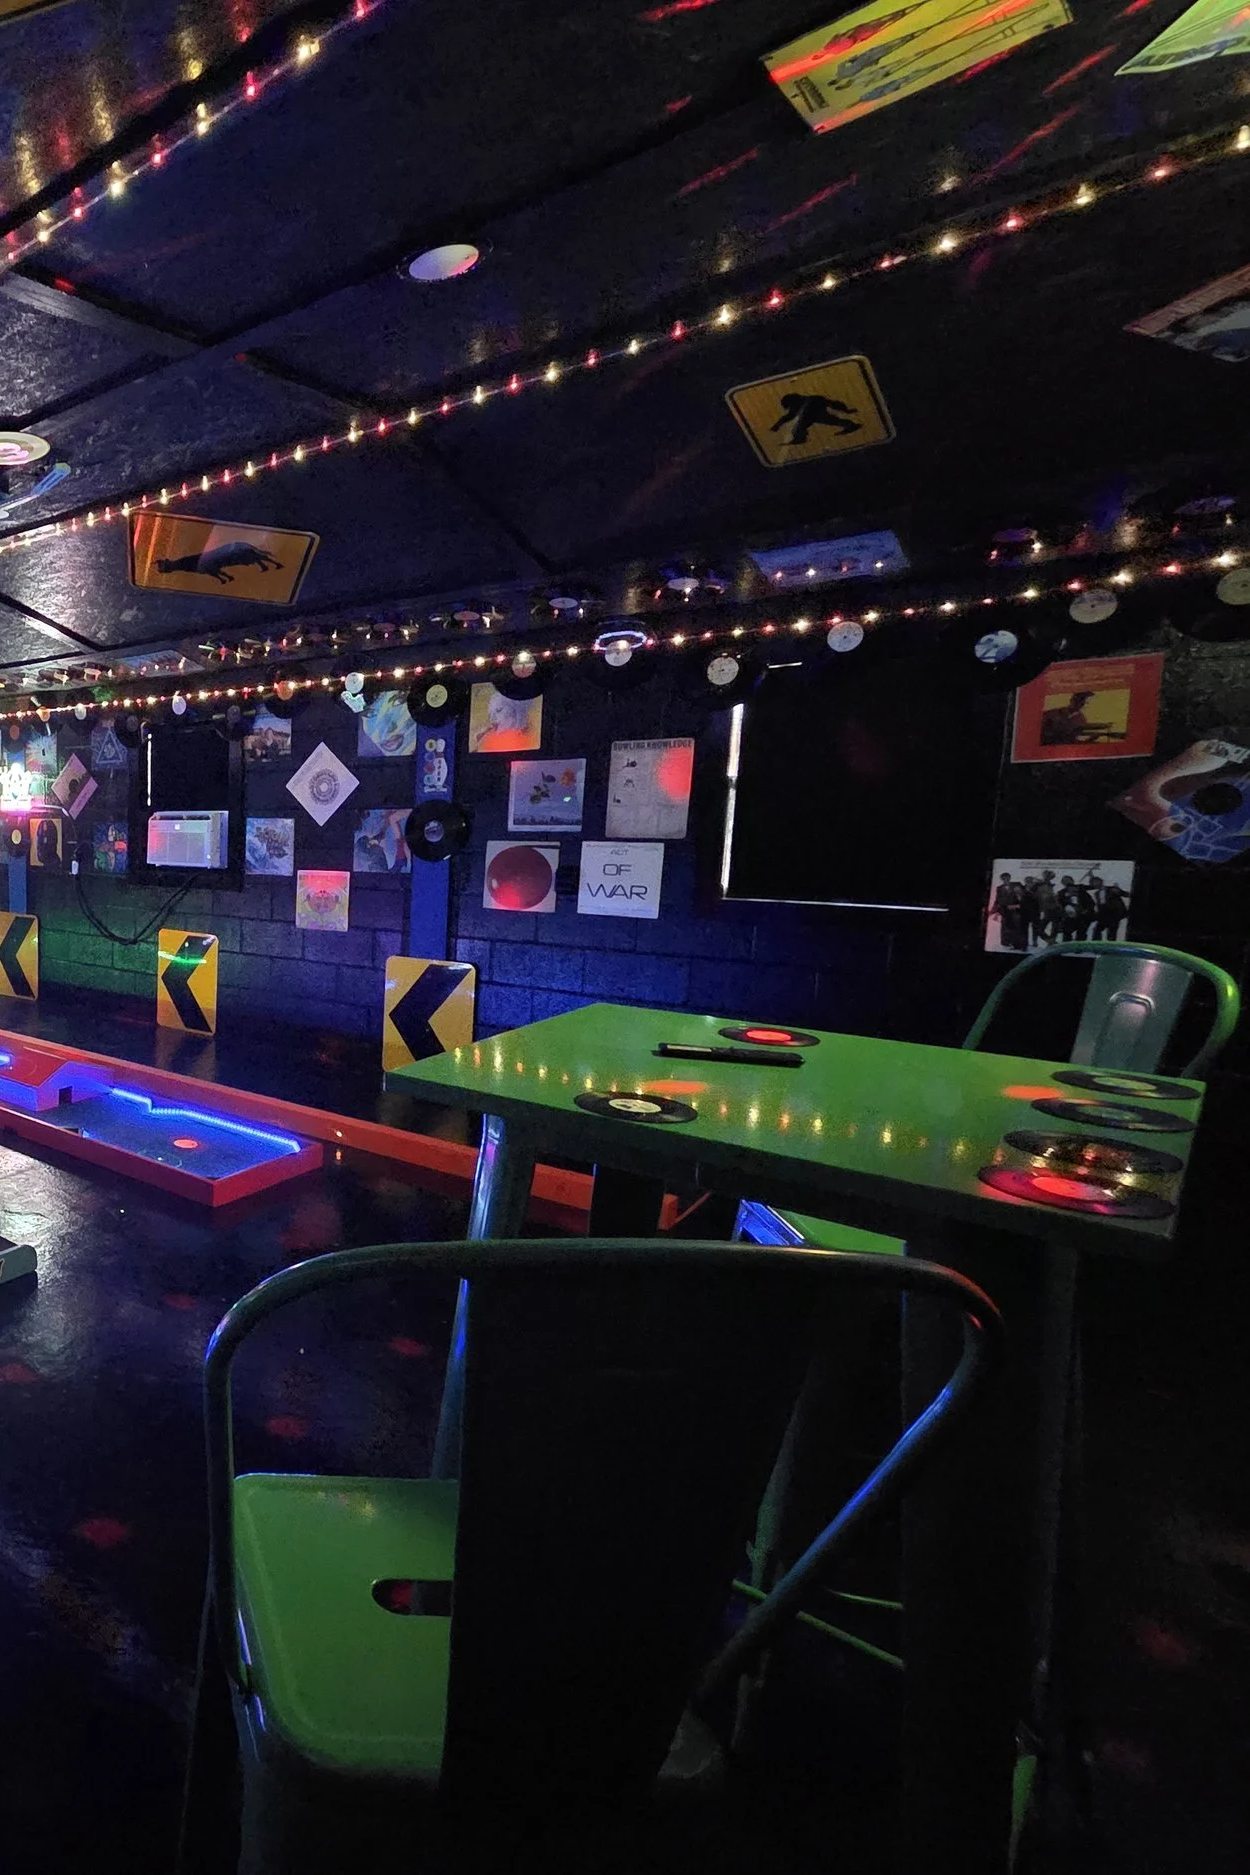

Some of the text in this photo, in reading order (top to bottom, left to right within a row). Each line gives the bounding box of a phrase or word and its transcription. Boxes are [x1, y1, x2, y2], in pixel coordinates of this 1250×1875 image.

[612, 739, 693, 751] BOWLING KNOWLEDGE
[603, 863, 632, 876] OF
[586, 882, 649, 901] WAR
